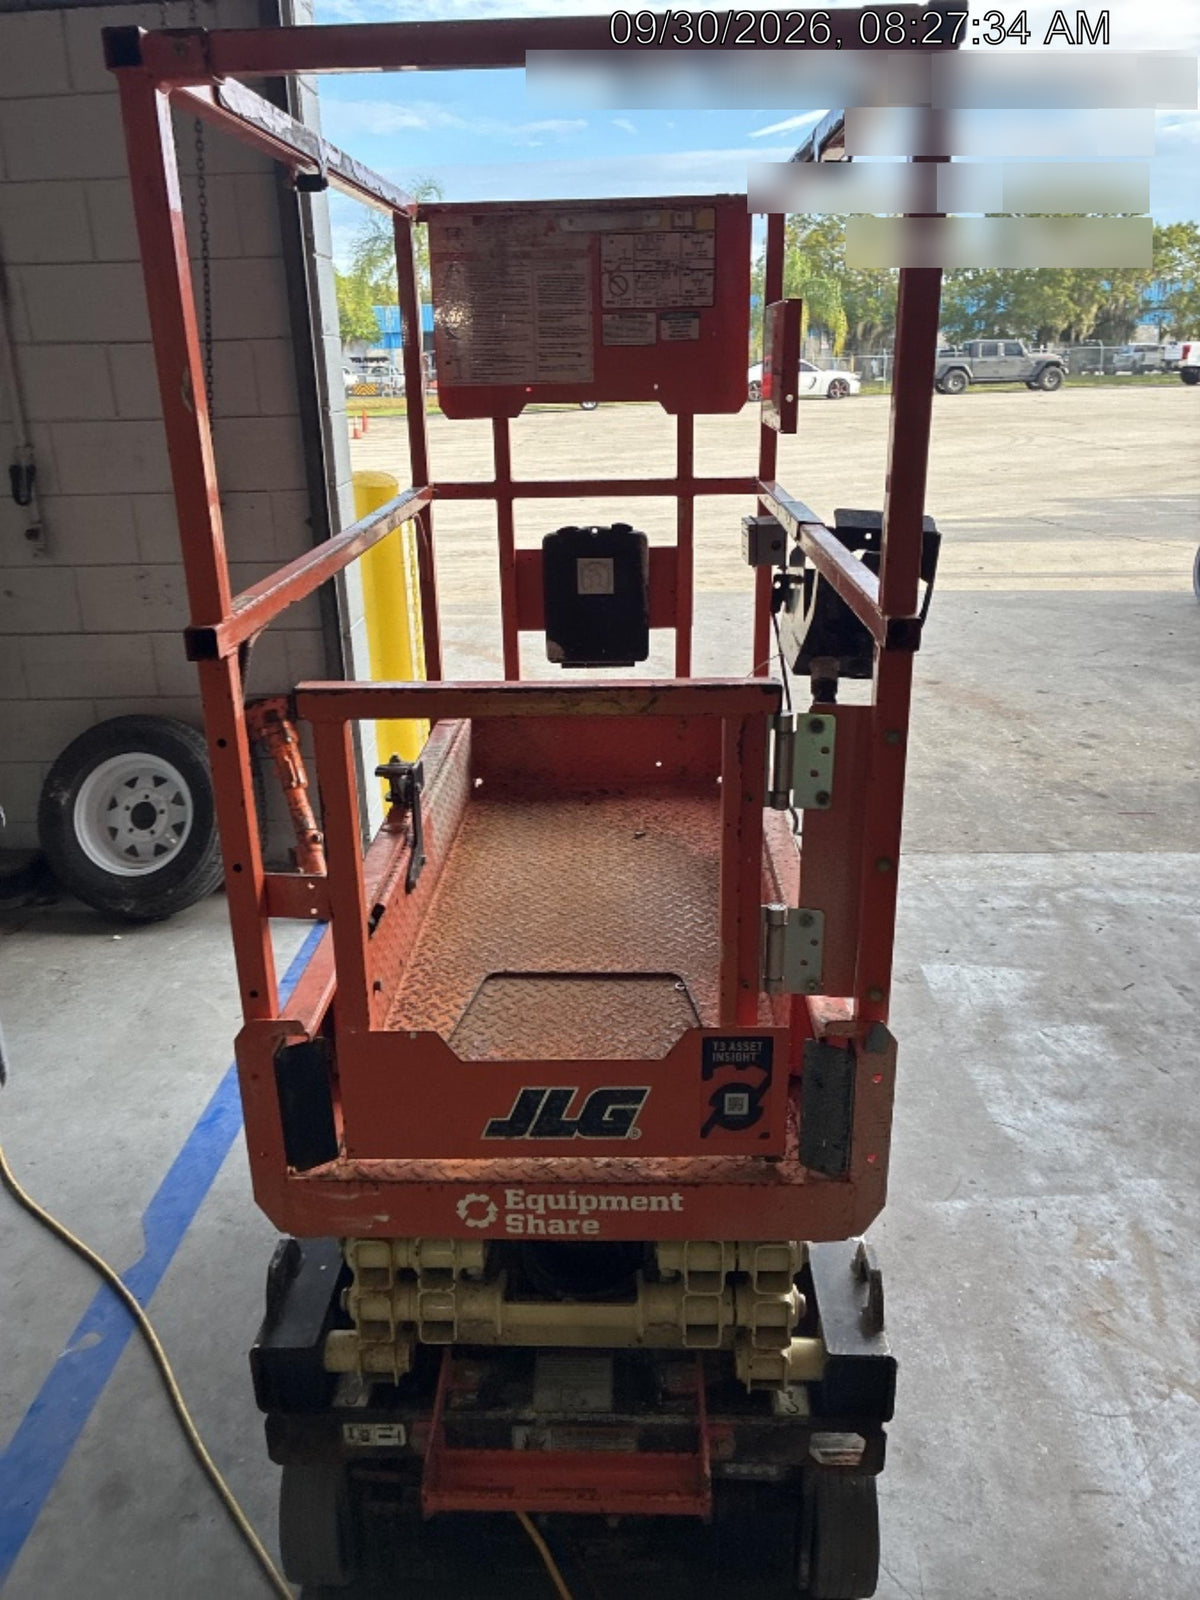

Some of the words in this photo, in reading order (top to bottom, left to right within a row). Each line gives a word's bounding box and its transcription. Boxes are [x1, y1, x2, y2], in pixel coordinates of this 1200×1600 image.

[712, 1041, 727, 1052] T3
[728, 1041, 764, 1052] ASSET
[712, 1052, 757, 1062] INSIGHT
[504, 1188, 684, 1215] Equipment
[505, 1214, 600, 1235] Share
